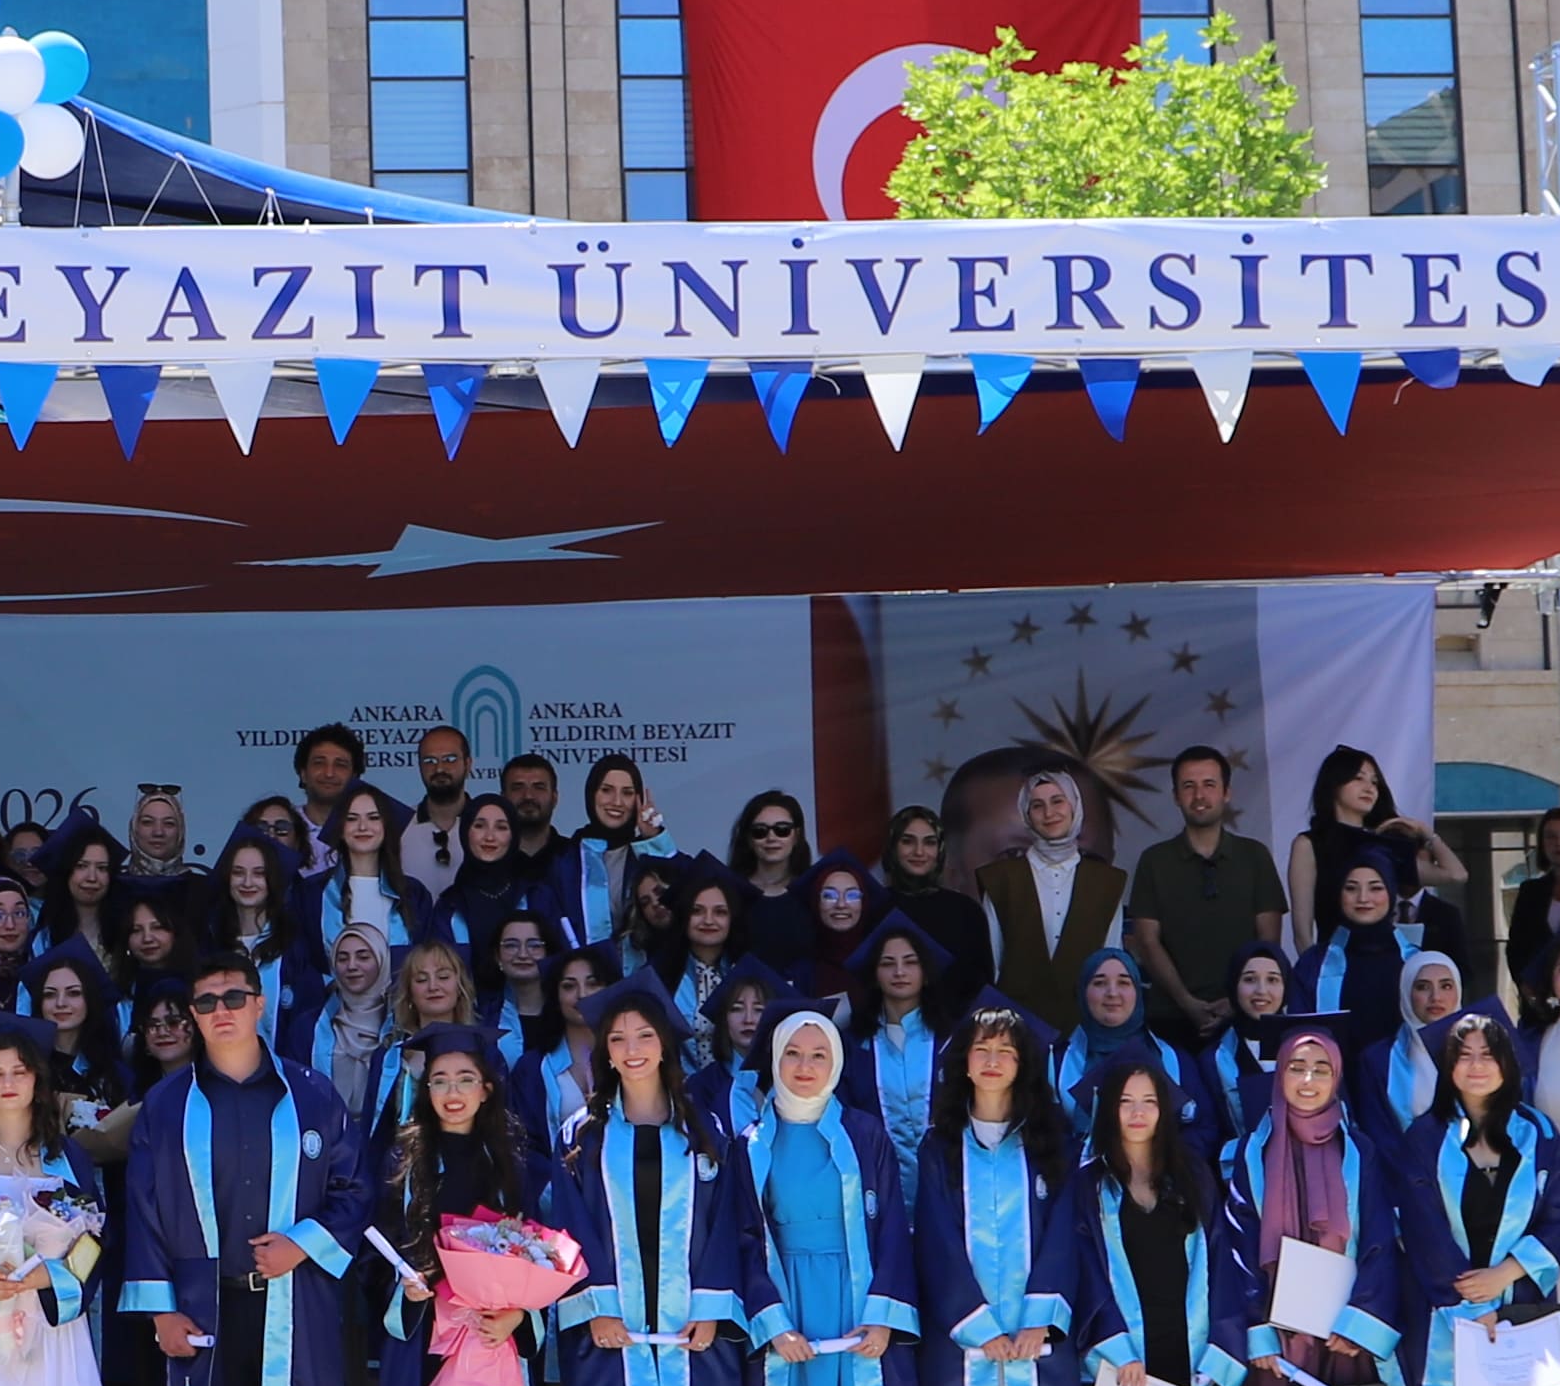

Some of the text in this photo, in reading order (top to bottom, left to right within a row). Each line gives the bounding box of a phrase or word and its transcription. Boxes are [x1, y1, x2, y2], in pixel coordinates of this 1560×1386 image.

[349, 704, 445, 723] ANKARA
[528, 702, 624, 720] ANKARA
[529, 722, 736, 742] YILDIRIM BEYAZIT
